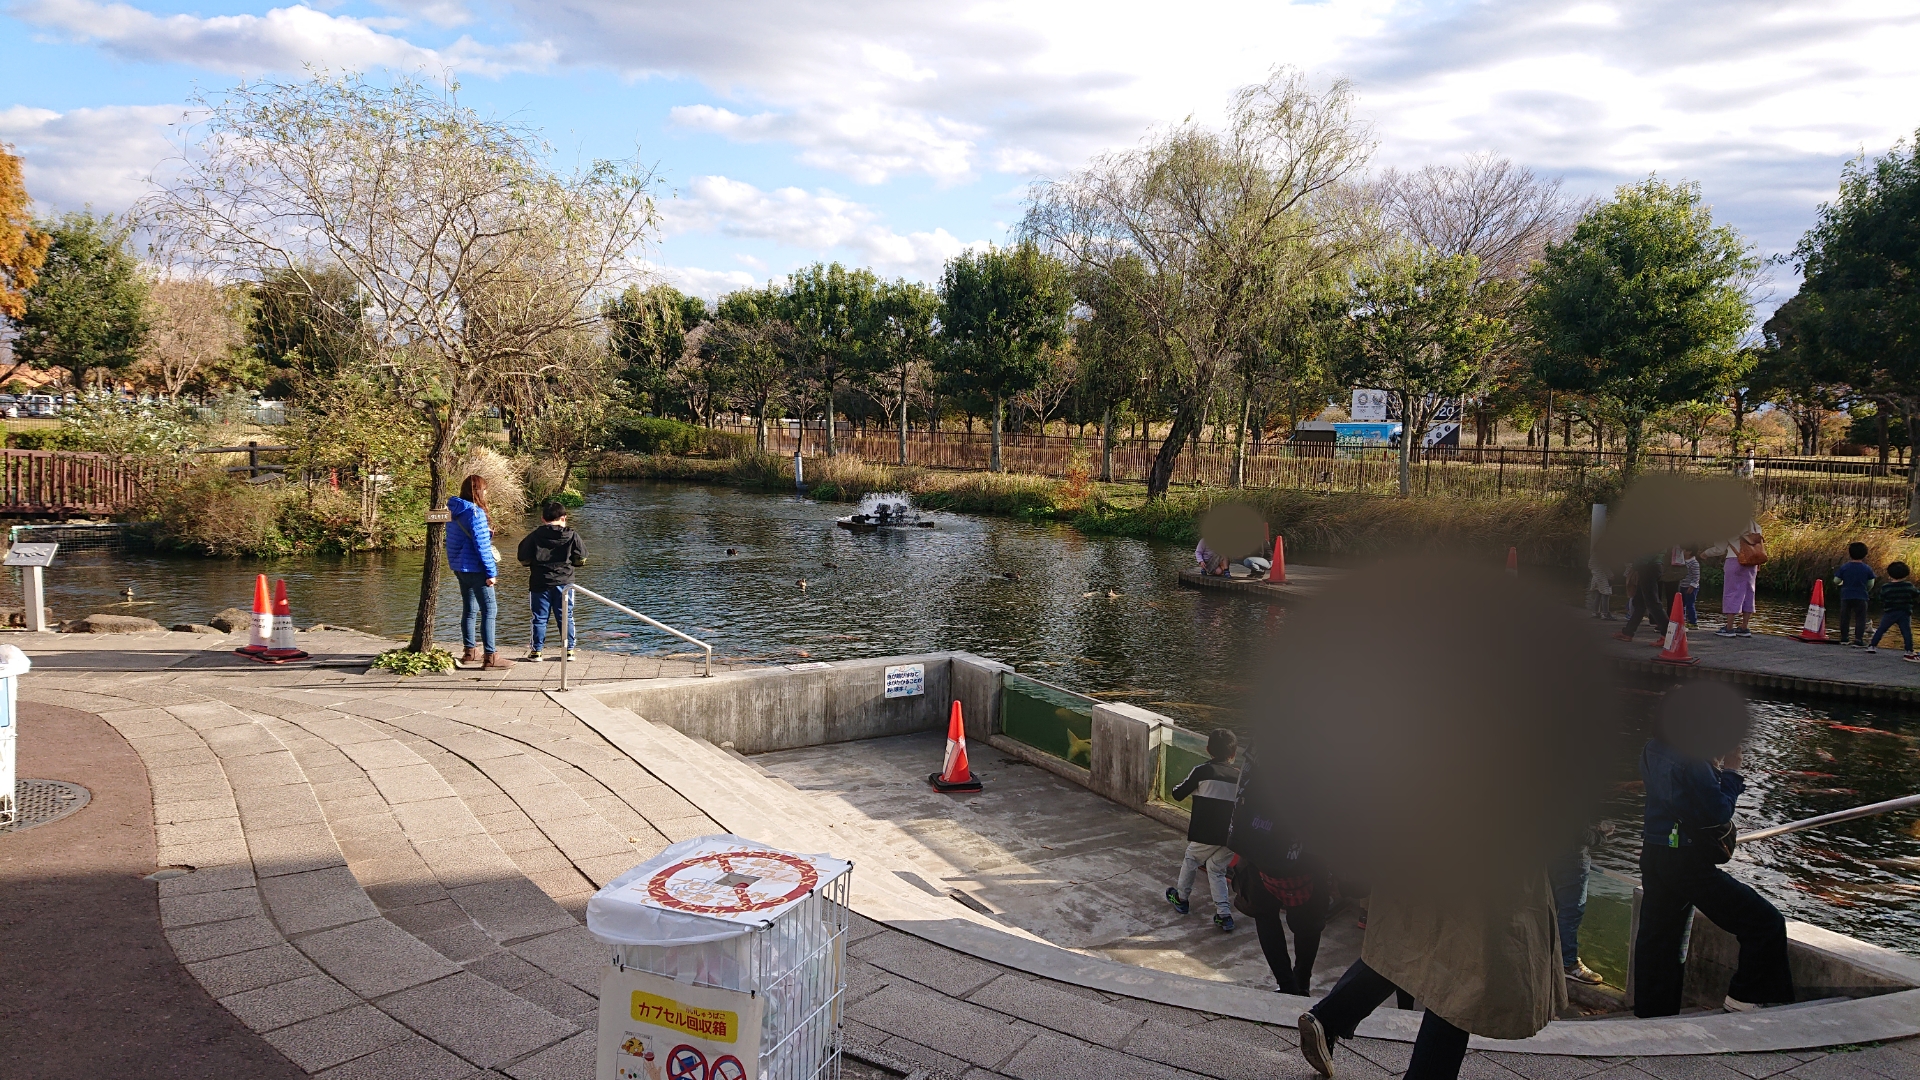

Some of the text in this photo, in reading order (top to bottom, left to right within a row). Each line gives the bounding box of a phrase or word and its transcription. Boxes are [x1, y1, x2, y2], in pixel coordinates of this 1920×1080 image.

[638, 1001, 728, 1038] カプセル回収箱
